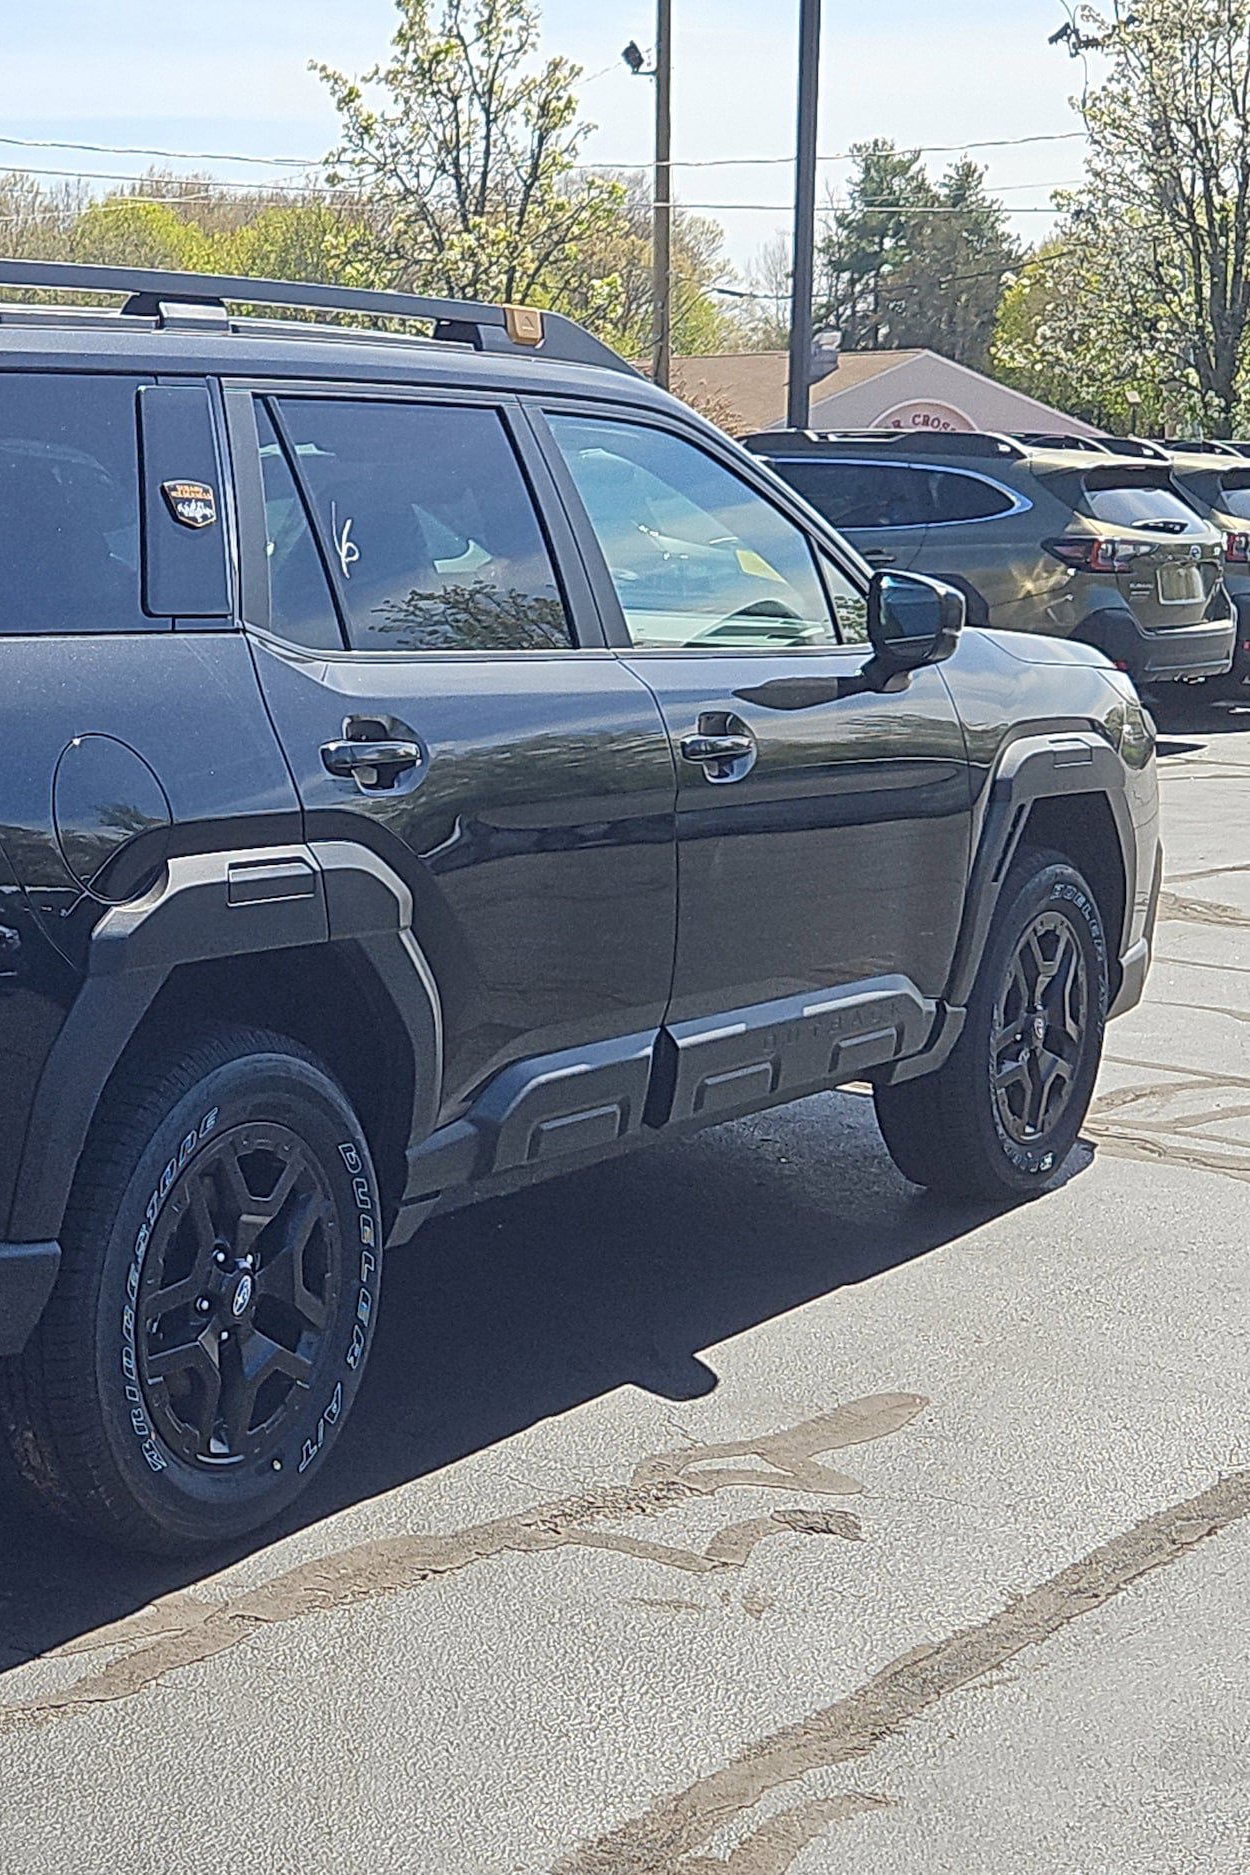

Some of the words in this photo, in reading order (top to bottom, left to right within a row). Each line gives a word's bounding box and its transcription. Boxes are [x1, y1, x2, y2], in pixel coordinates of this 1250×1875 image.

[911, 413, 956, 431] CROS
[122, 1106, 219, 1472] BRIDGESTONE
[338, 1142, 374, 1370] DUELER
